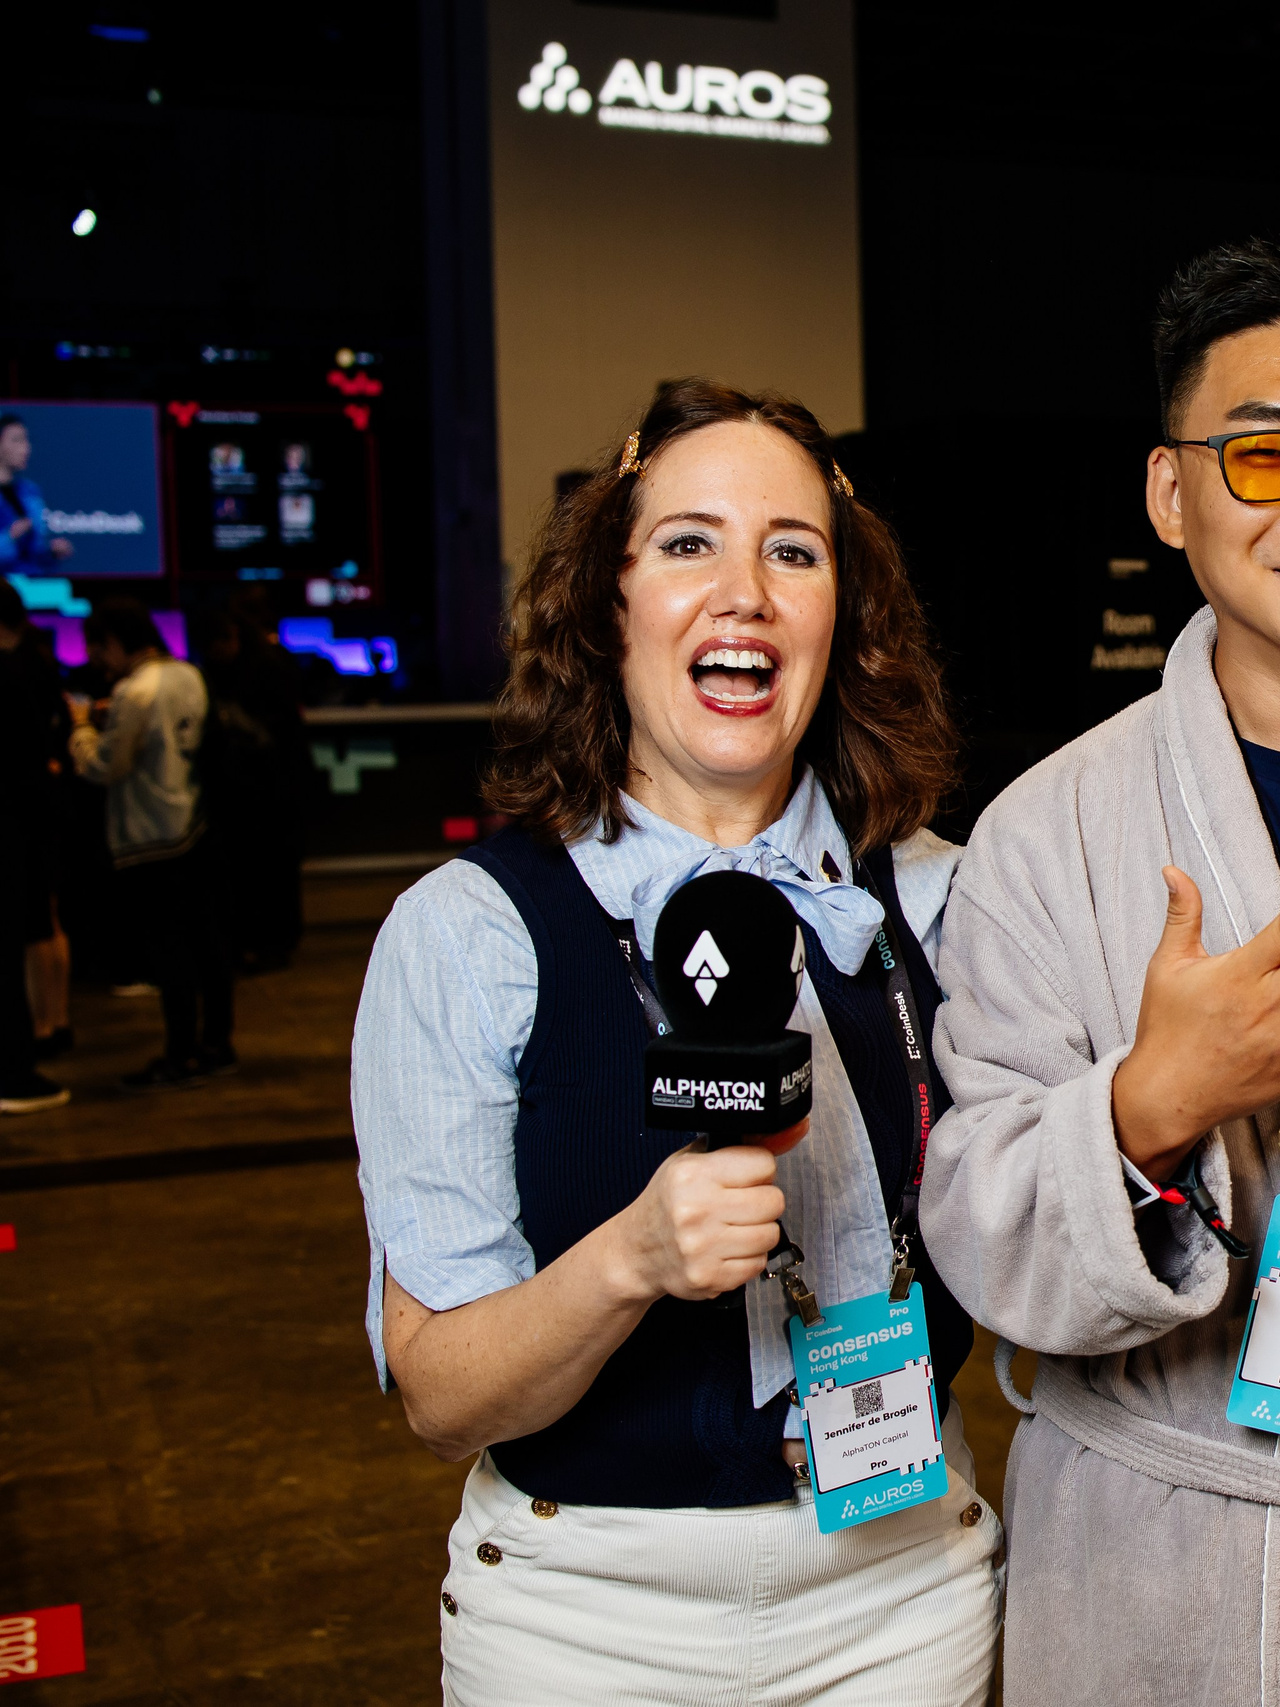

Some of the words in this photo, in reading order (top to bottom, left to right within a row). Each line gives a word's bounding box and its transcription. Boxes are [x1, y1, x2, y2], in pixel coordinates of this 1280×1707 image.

[599, 58, 832, 124] AUROS
[894, 991, 916, 1045] CoinDesk
[652, 1077, 766, 1099] ALPHATON
[704, 1098, 765, 1111] CAPITAL
[889, 1306, 909, 1319] Pro
[813, 1325, 843, 1338] CoinDesk
[810, 1360, 839, 1375] Hong
[840, 1350, 869, 1366] Kong
[824, 1419, 867, 1441] Jennifer
[867, 1416, 881, 1426] de
[882, 1403, 918, 1423] Broglie
[841, 1439, 881, 1459] AlphaTON
[882, 1430, 909, 1447] Capital
[870, 1459, 888, 1471] Pro
[863, 1479, 925, 1510] AUROS
